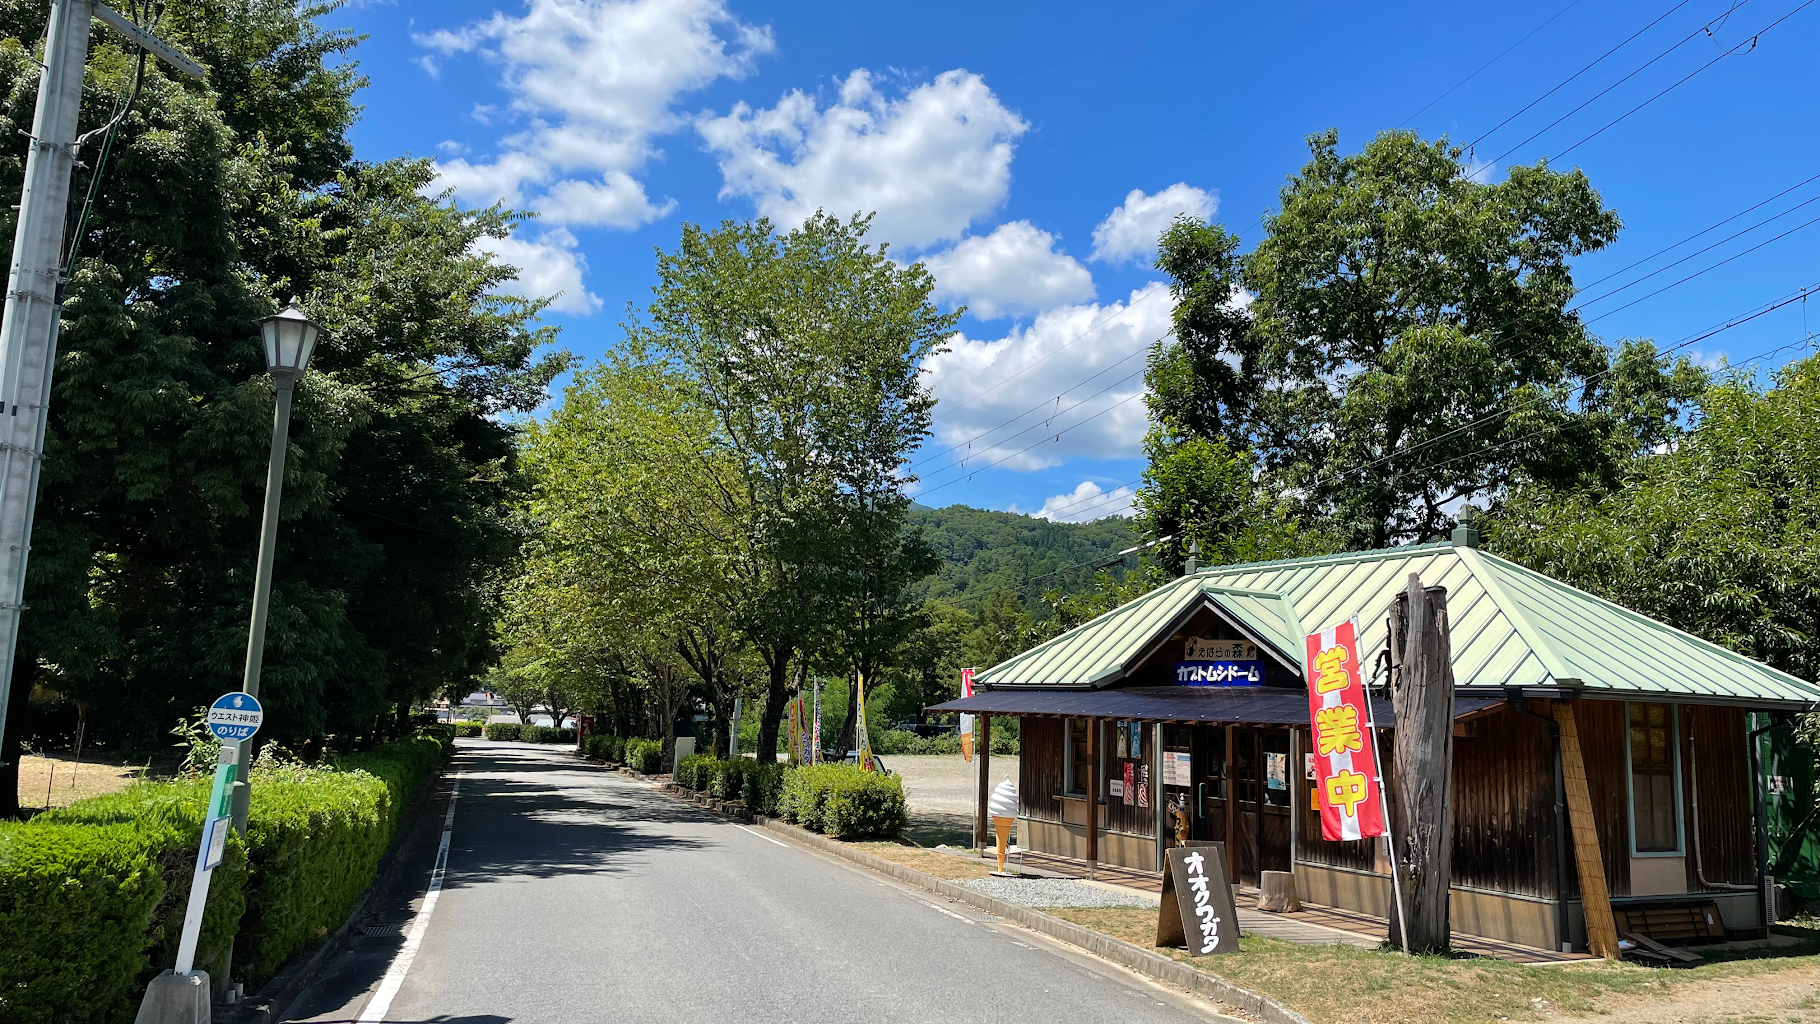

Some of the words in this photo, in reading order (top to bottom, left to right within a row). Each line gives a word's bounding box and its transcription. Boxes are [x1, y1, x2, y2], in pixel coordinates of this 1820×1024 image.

[1198, 643, 1243, 658] えばらの森
[1177, 665, 1260, 681] カブトムシドーム
[211, 712, 260, 723] ウエスト神姫
[217, 726, 249, 737] のりば
[1313, 644, 1367, 817] 営業中
[1184, 851, 1221, 954] オオクワガタ
